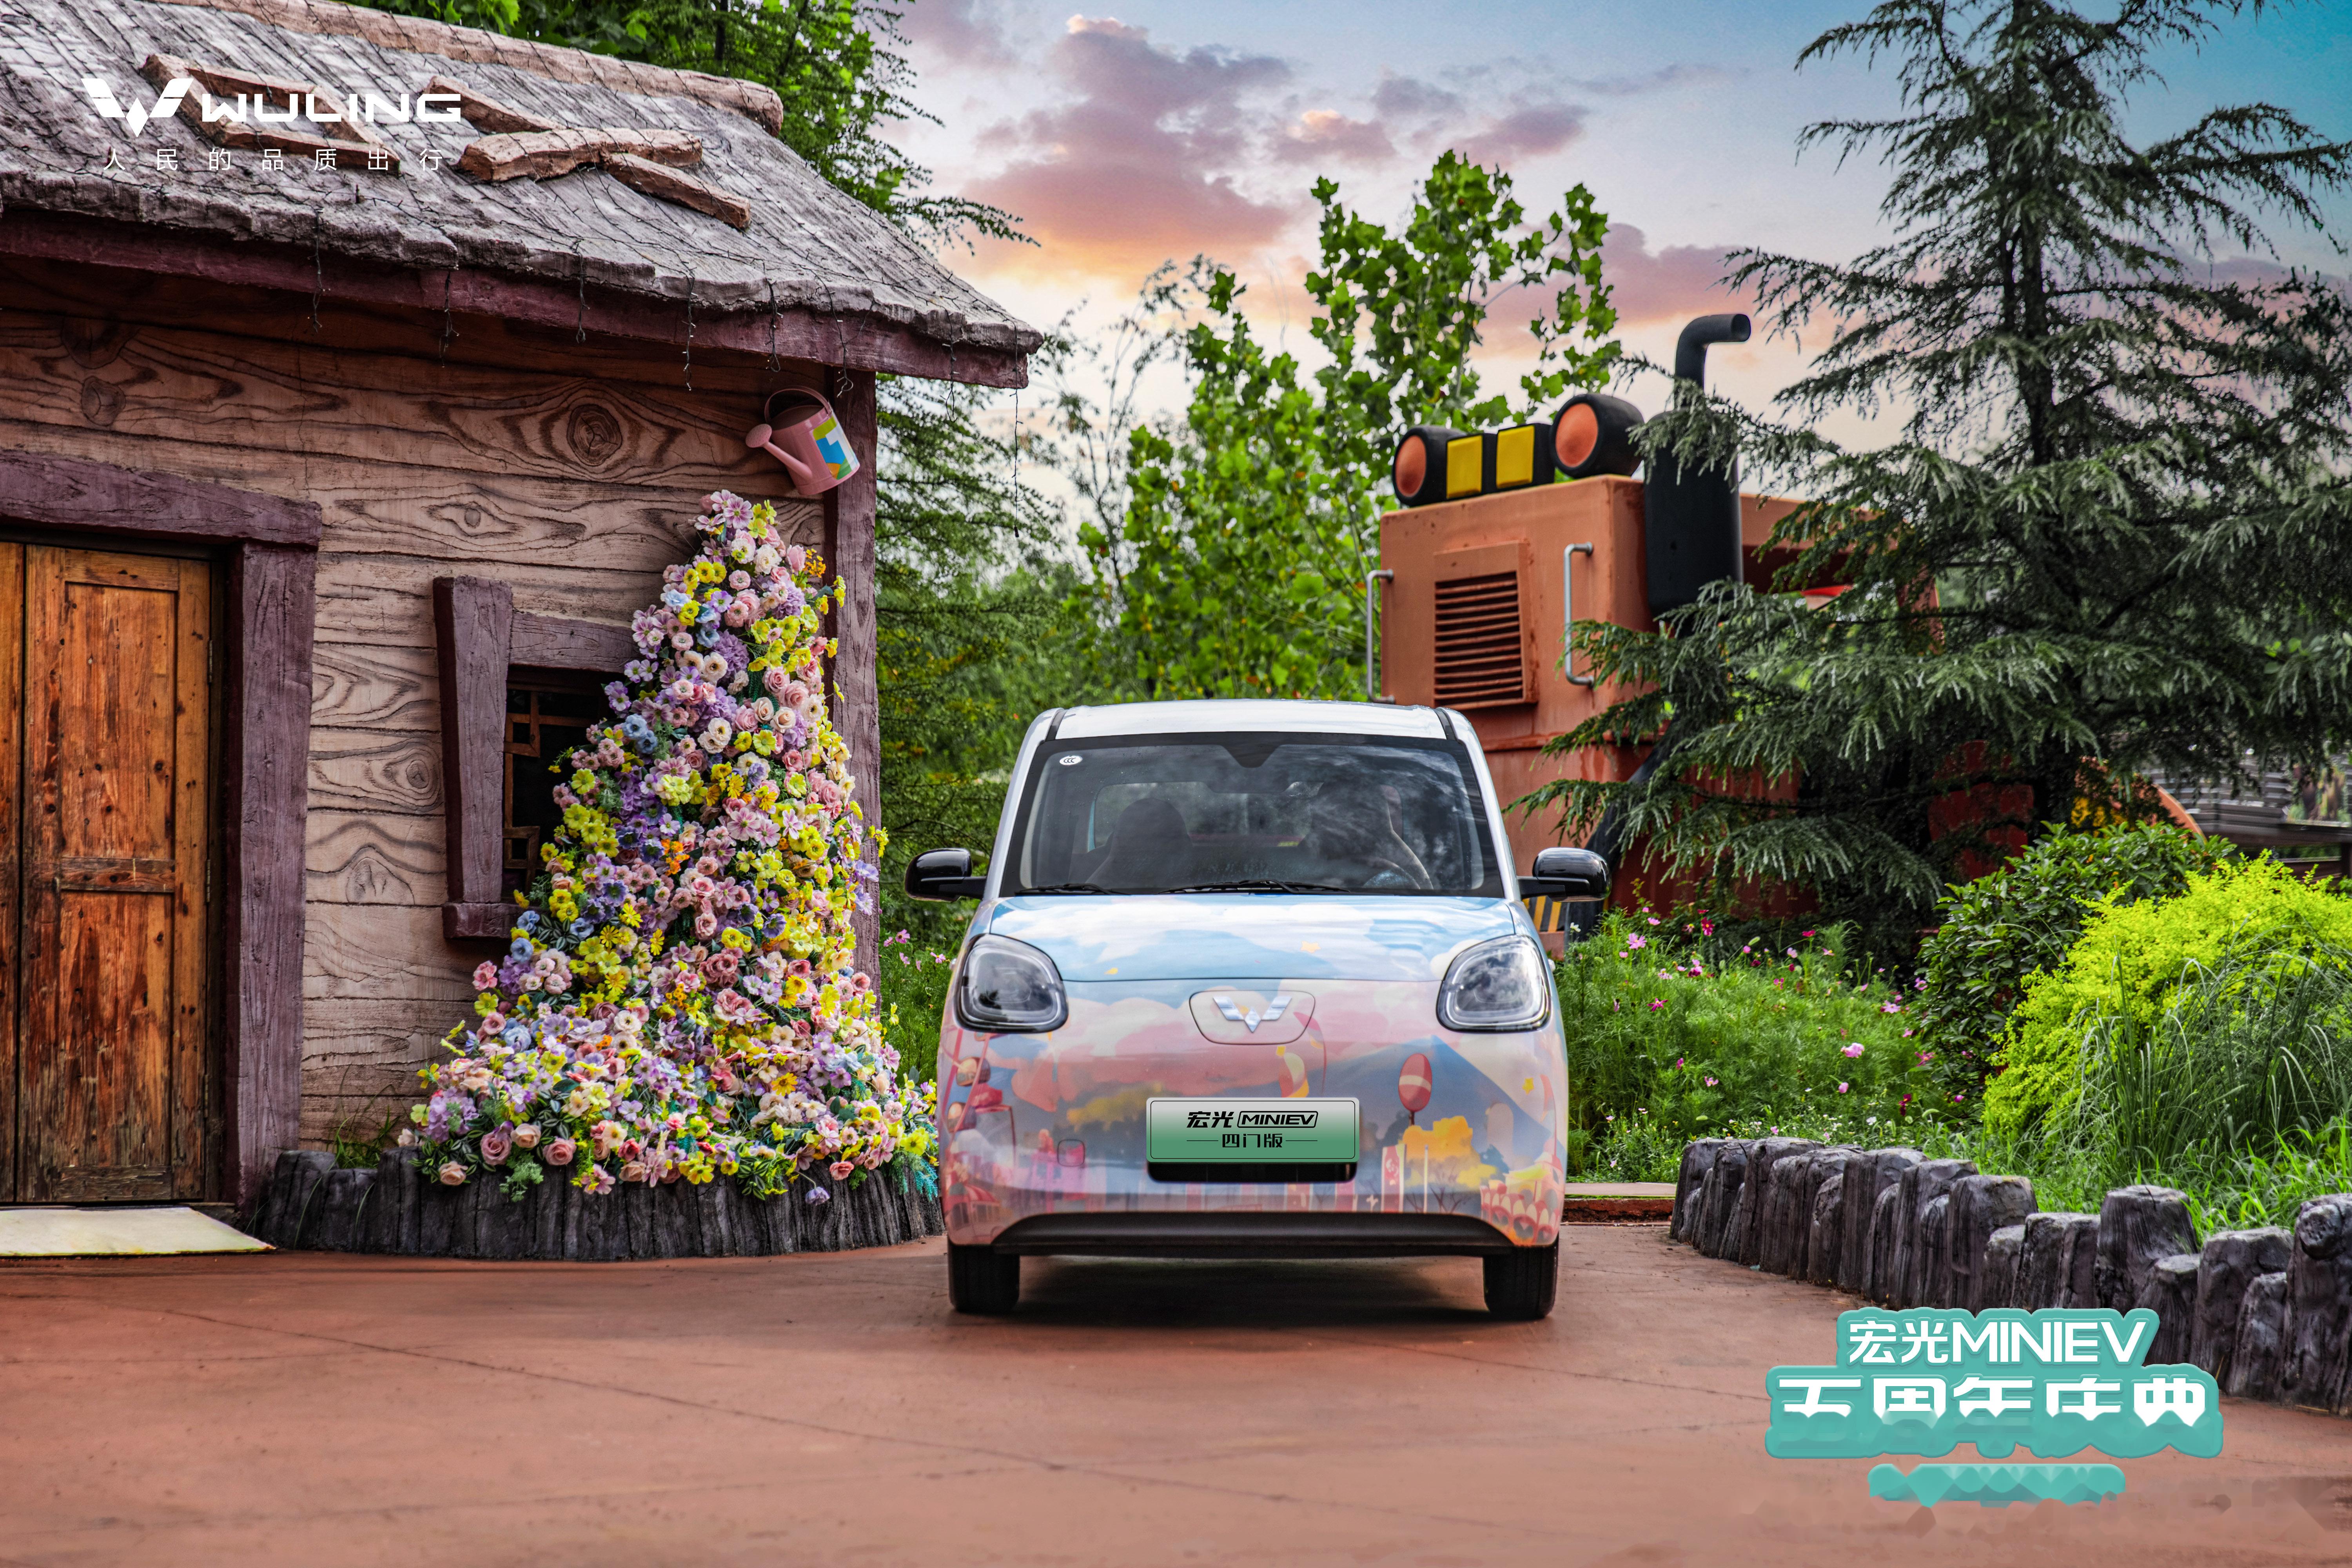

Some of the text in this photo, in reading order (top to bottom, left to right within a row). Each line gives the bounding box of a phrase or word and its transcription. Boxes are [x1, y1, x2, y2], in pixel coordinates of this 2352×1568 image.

[1186, 1111, 1315, 1128] 宏光 MINIEV
[1222, 1133, 1283, 1148] 四门版
